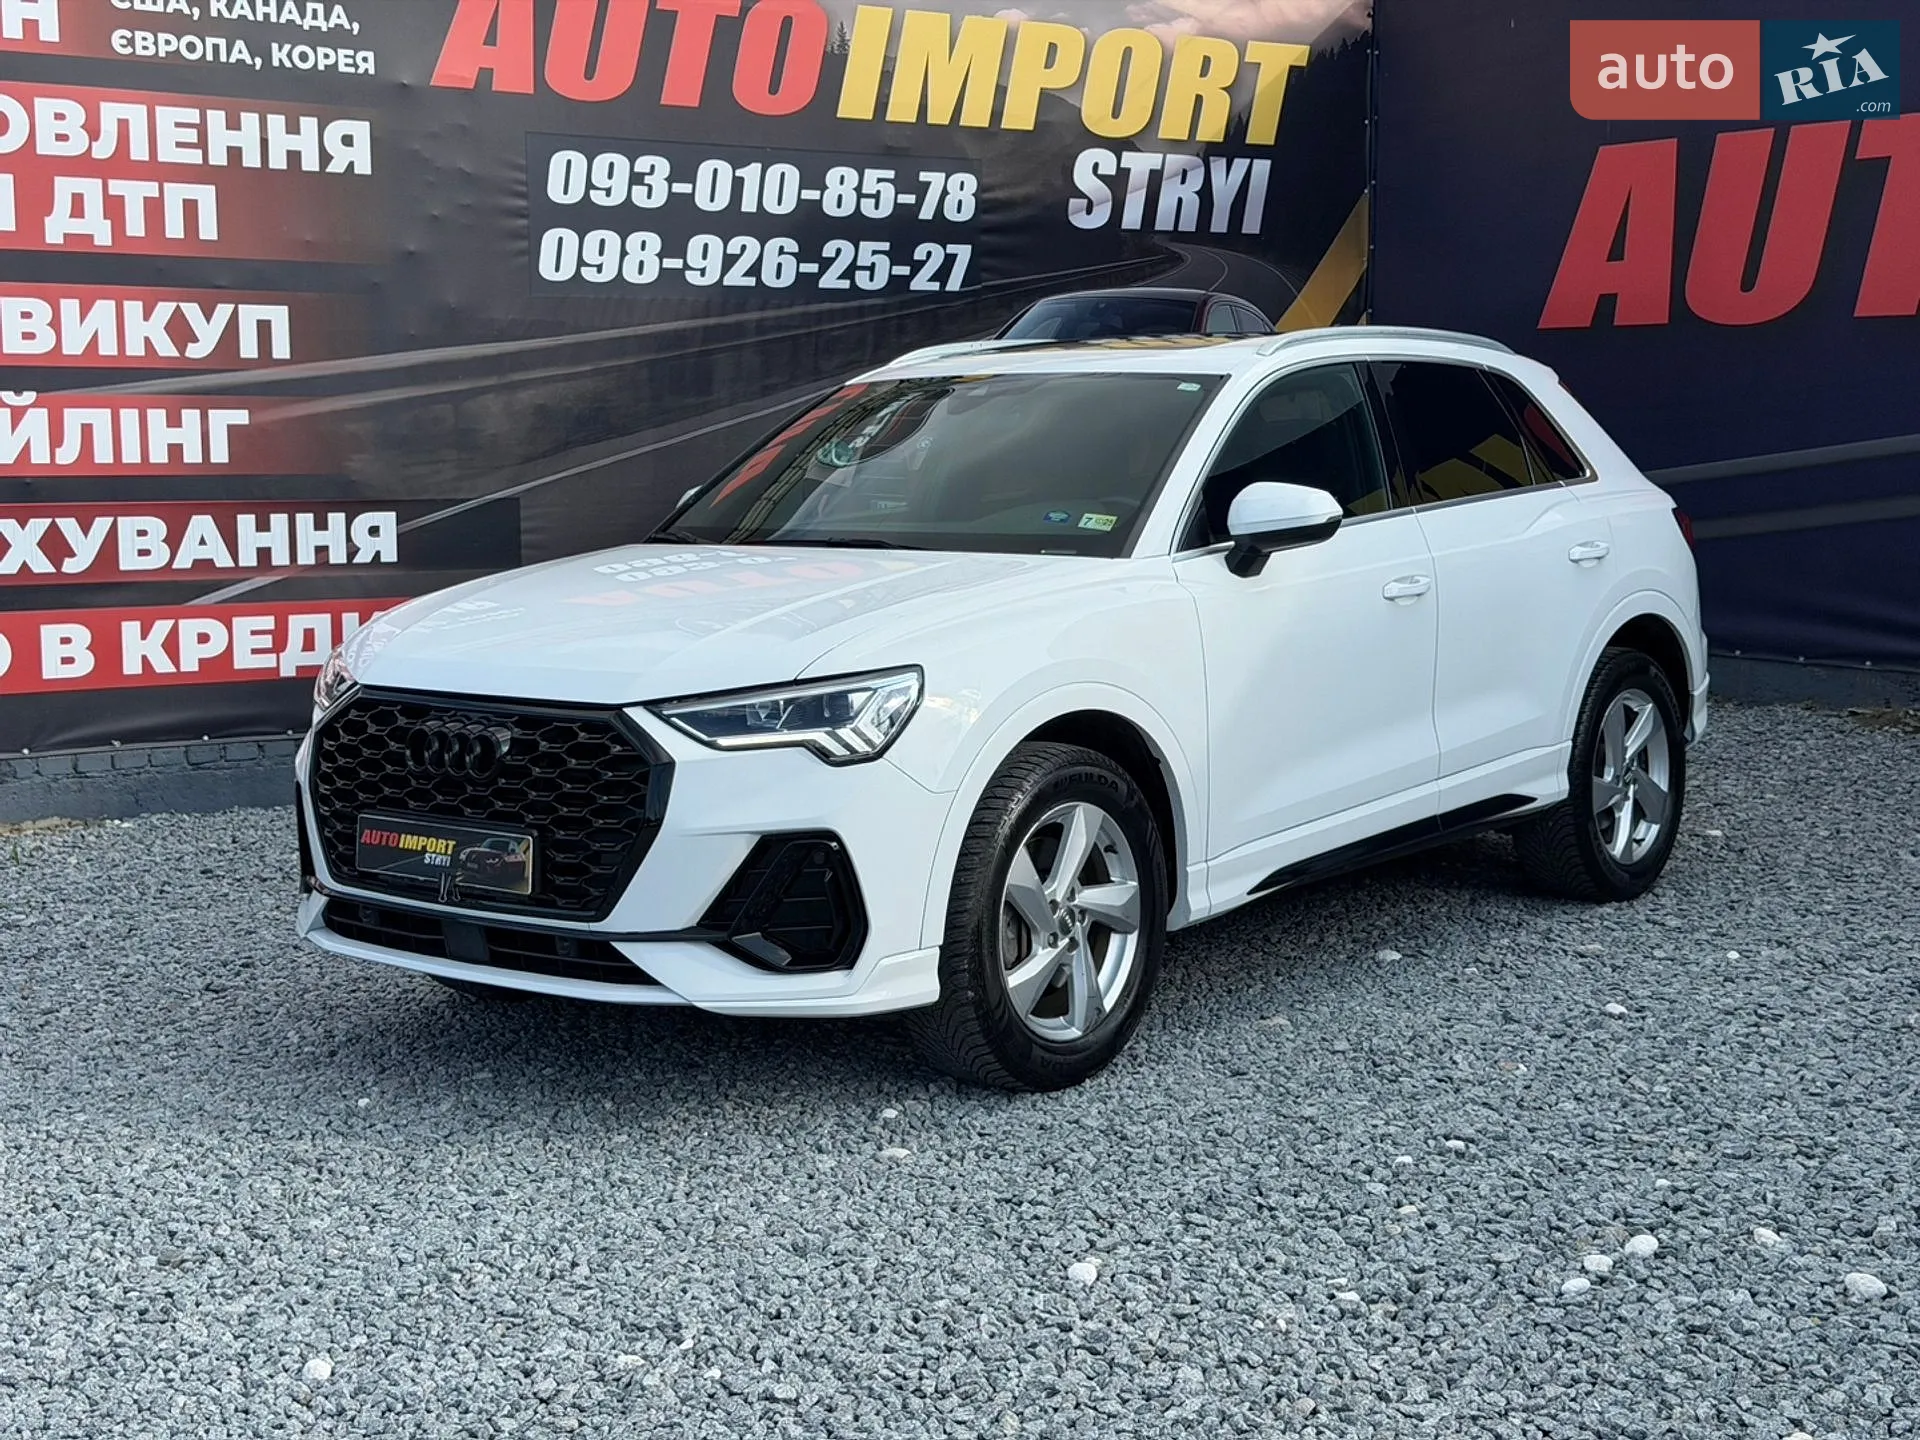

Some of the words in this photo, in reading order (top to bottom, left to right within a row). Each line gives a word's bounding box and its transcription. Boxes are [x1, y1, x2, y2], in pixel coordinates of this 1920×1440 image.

[210, 0, 360, 35] КАНАДА,
[110, 28, 262, 71] ЄВРОПА,
[271, 42, 375, 76] КОРЕЯ
[44, 176, 219, 246] ДТП
[546, 150, 978, 223] 093-010-85-78
[1068, 148, 1272, 235] STRYI
[538, 227, 973, 292] 098-926-25-27
[0, 296, 292, 360] ВИКУП
[0, 391, 250, 465] ЙЛІНГ
[0, 511, 398, 574] ХУВАННЯ
[40, 623, 95, 679] В
